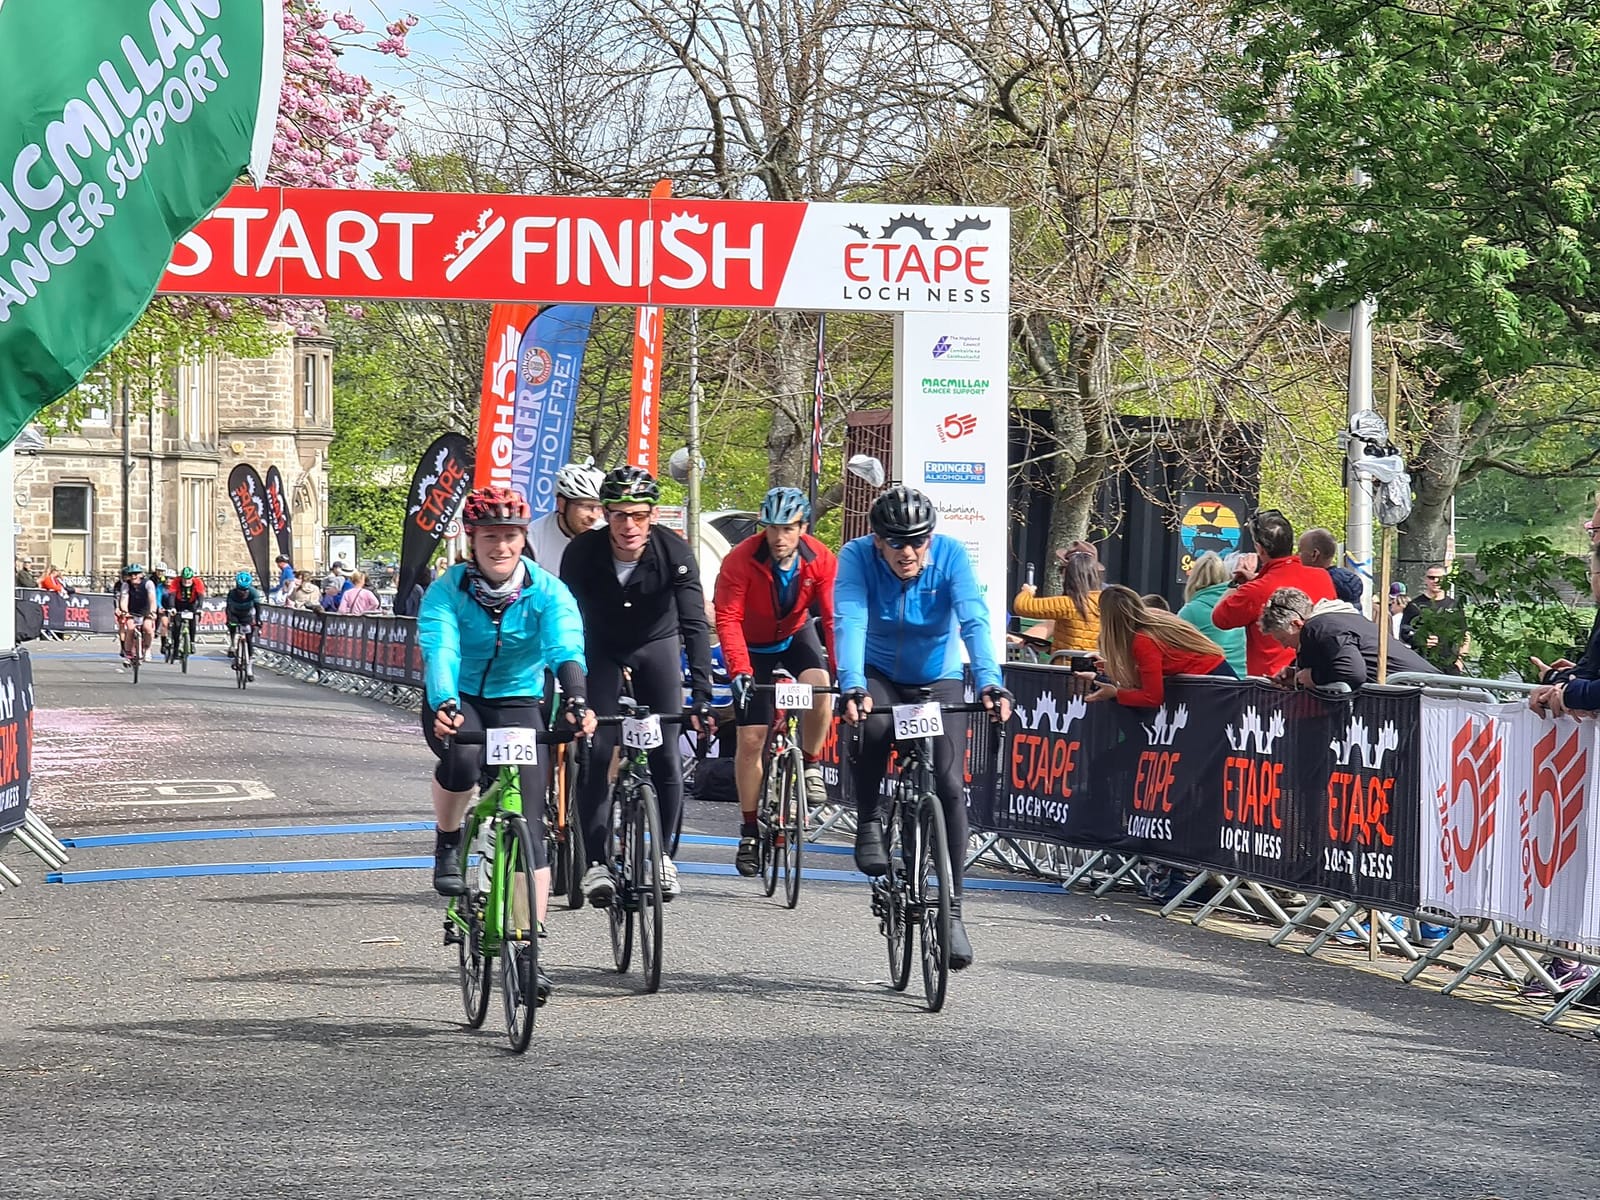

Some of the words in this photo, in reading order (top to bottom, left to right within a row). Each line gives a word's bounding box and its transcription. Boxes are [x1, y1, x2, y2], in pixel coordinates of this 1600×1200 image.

[107, 34, 229, 199] SUPPORT
[166, 207, 435, 281] START
[511, 210, 764, 289] FINISH
[844, 242, 991, 285] ETAPE
[844, 286, 910, 301] LOCH
[927, 288, 991, 303] NESS
[921, 378, 989, 388] MACMILLAN
[935, 423, 947, 444] HIGH
[926, 462, 973, 474] ERDINGER
[416, 458, 465, 531] ETAPE
[430, 505, 453, 540] LOCH
[451, 472, 470, 503] NESS
[944, 510, 986, 525] concepts
[65, 606, 90, 622] ETAPE
[778, 694, 810, 706] 4910
[626, 731, 661, 746] 4124
[899, 717, 940, 735] 3508
[492, 744, 533, 761] 4126
[1011, 733, 1081, 798] ETAPE
[1223, 756, 1284, 830] ETAPE
[1327, 771, 1395, 847] ETAPE
[1254, 832, 1282, 860] NESS
[1436, 782, 1454, 895] HIGH
[1518, 789, 1533, 911] HIGH
